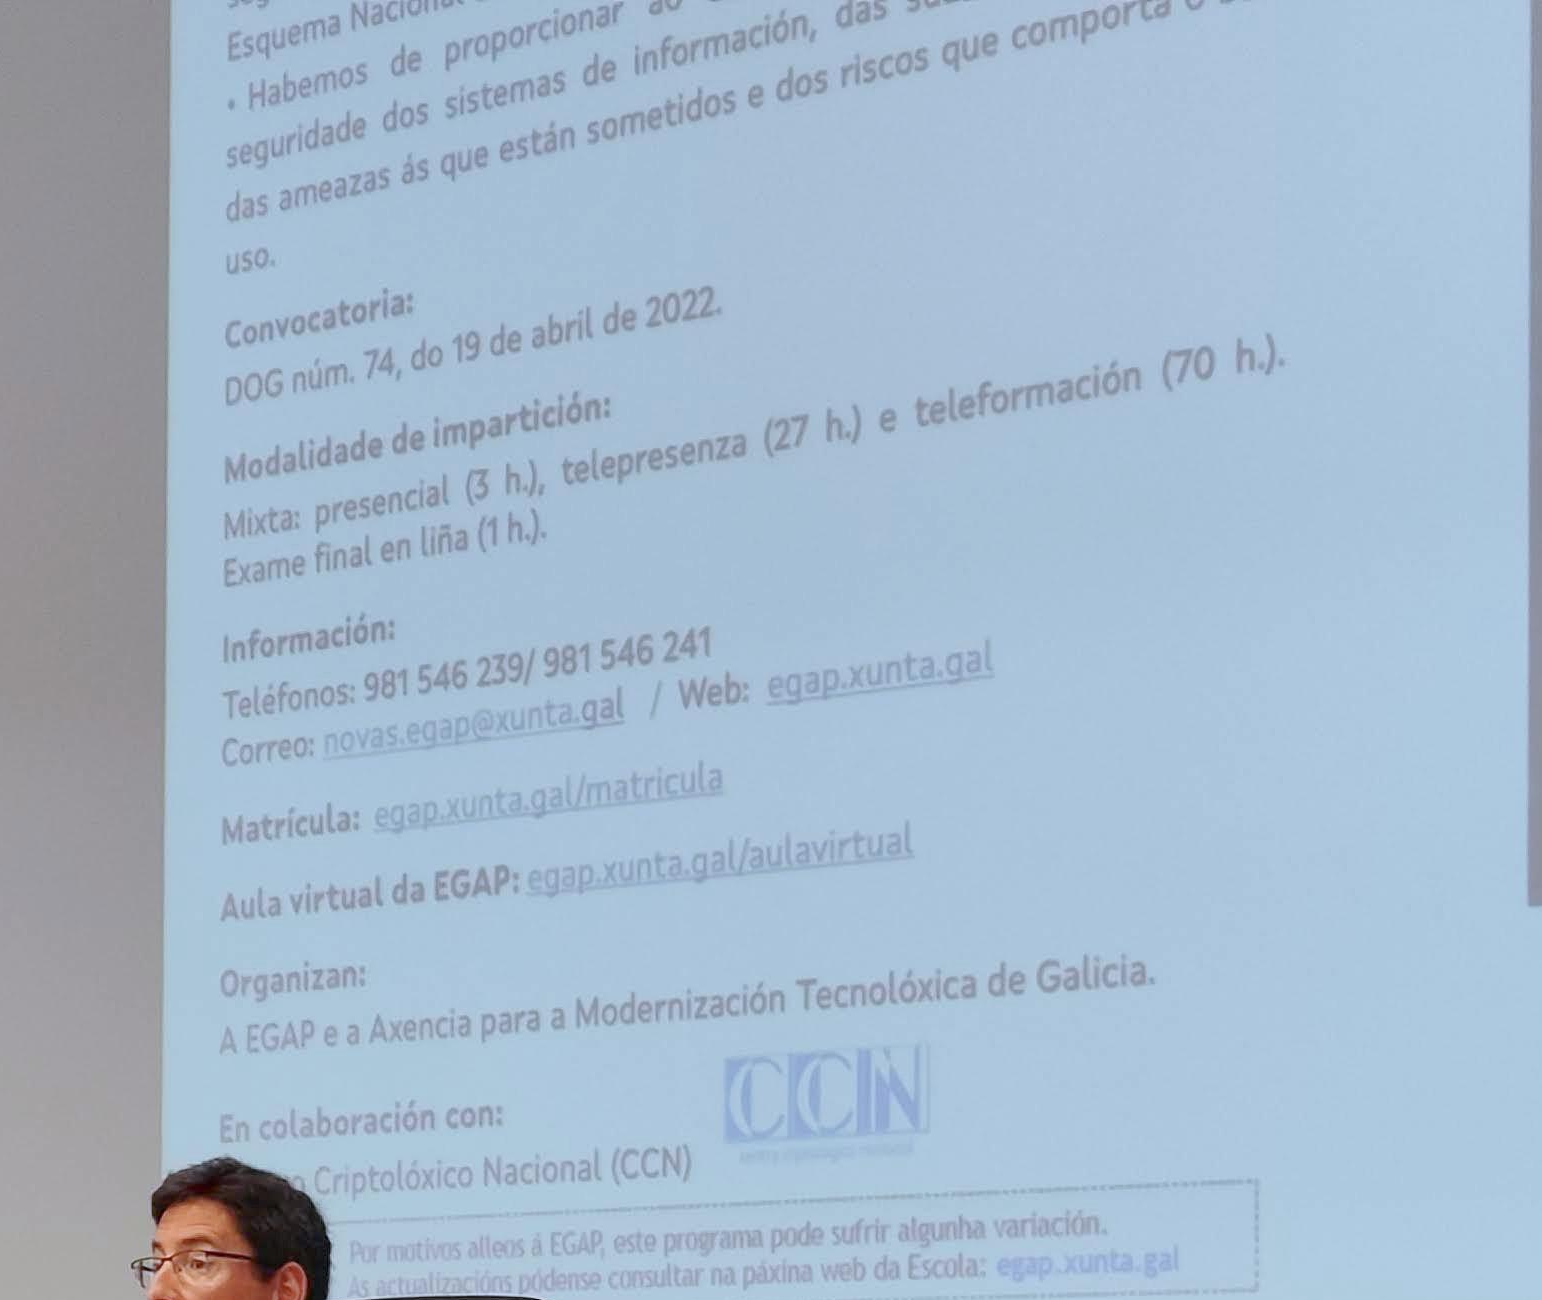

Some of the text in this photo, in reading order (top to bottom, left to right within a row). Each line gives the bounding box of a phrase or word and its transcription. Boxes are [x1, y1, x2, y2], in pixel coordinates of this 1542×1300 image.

[226, 15, 342, 63] Esquema
[247, 61, 368, 112] Habemos
[390, 44, 423, 78] de
[444, 0, 624, 72] proporcionar
[226, 111, 367, 170] seguridade
[382, 95, 428, 135] dos
[444, 68, 566, 119] sistemas
[582, 52, 616, 88] de
[633, 10, 819, 76] información,
[226, 0, 1171, 223] das ameazas ás que están sometidos e dos riscos que comporta
[225, 246, 276, 276] uso.
[225, 288, 414, 349] Convocatoria:
[225, 285, 723, 406] DOG núm. 74, do 19 de abril de 2022.
[224, 333, 1286, 541] Mixta: presencial (3 h.), telepresenza (27 h.) e teleformación (70 h.).
[224, 391, 612, 485] Modalidade de impartición:
[223, 508, 547, 588] Exame final en liña (1 h.).
[222, 612, 395, 663] Información:
[222, 679, 356, 719] Teléfonos:
[363, 668, 409, 703] 981
[417, 659, 468, 695] 546
[543, 643, 591, 678] 981
[600, 634, 654, 670] 546
[662, 626, 712, 662] 241
[221, 734, 315, 768] Correo:
[324, 688, 624, 758] novas.egap@xunta.gal
[677, 671, 750, 710] Web:
[767, 637, 995, 705] egap.xunta.gal
[221, 803, 360, 845] Matrícula:
[220, 820, 914, 922] Aula virtual da EGAP: egap.xunta.gal/aulavirtual
[220, 961, 367, 1002] Organizan:
[220, 954, 1156, 1056] A EGAP e a Axencia para a Modernización Tecnolóxica de Galicia.
[219, 1099, 504, 1143] En colaboración con:
[724, 1043, 930, 1143] CCN
[314, 1155, 473, 1199] Criptolóxico
[483, 1155, 602, 1188] Nacional
[611, 1144, 692, 1186] (CCN)
[347, 1277, 369, 1298] As
[518, 1265, 602, 1295] pódense
[608, 1262, 704, 1288] consultar
[710, 1265, 737, 1287] na
[743, 1258, 813, 1290] páxina
[821, 1257, 866, 1283] web
[873, 1257, 900, 1281] da
[907, 1253, 988, 1280] Escola:
[996, 1245, 1180, 1281] egap.xunta.gal
[349, 1239, 379, 1265] Por
[386, 1234, 461, 1262] motivos
[468, 1231, 525, 1260] alleos
[550, 1230, 606, 1259] EGAP,
[613, 1230, 656, 1254] este
[663, 1228, 764, 1261] programa
[770, 1218, 824, 1255] pode
[831, 1216, 892, 1246] sufrir
[897, 1213, 986, 1249] algunha
[992, 1209, 1108, 1239] variación.
